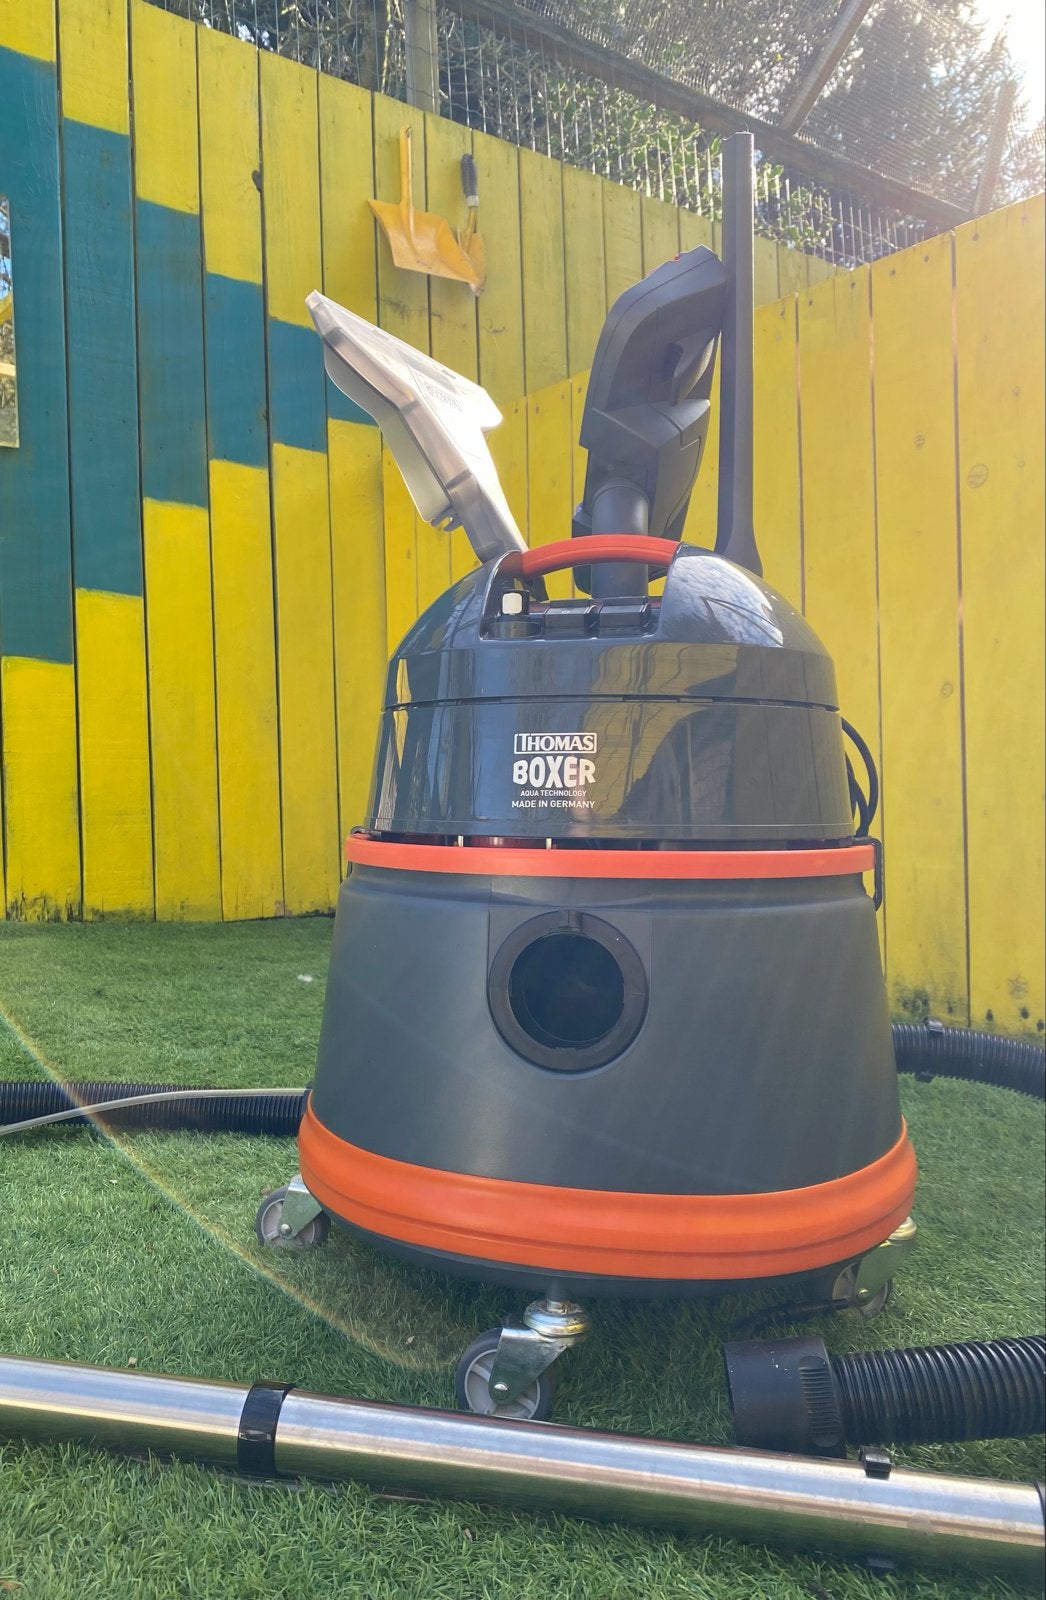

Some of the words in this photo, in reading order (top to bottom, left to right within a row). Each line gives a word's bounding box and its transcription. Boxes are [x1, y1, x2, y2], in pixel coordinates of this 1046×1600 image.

[517, 733, 595, 752] THOMAS
[513, 756, 596, 788] BOXER
[511, 800, 537, 808] MADE
[538, 800, 548, 808] IN
[550, 800, 596, 809] GERMANY
